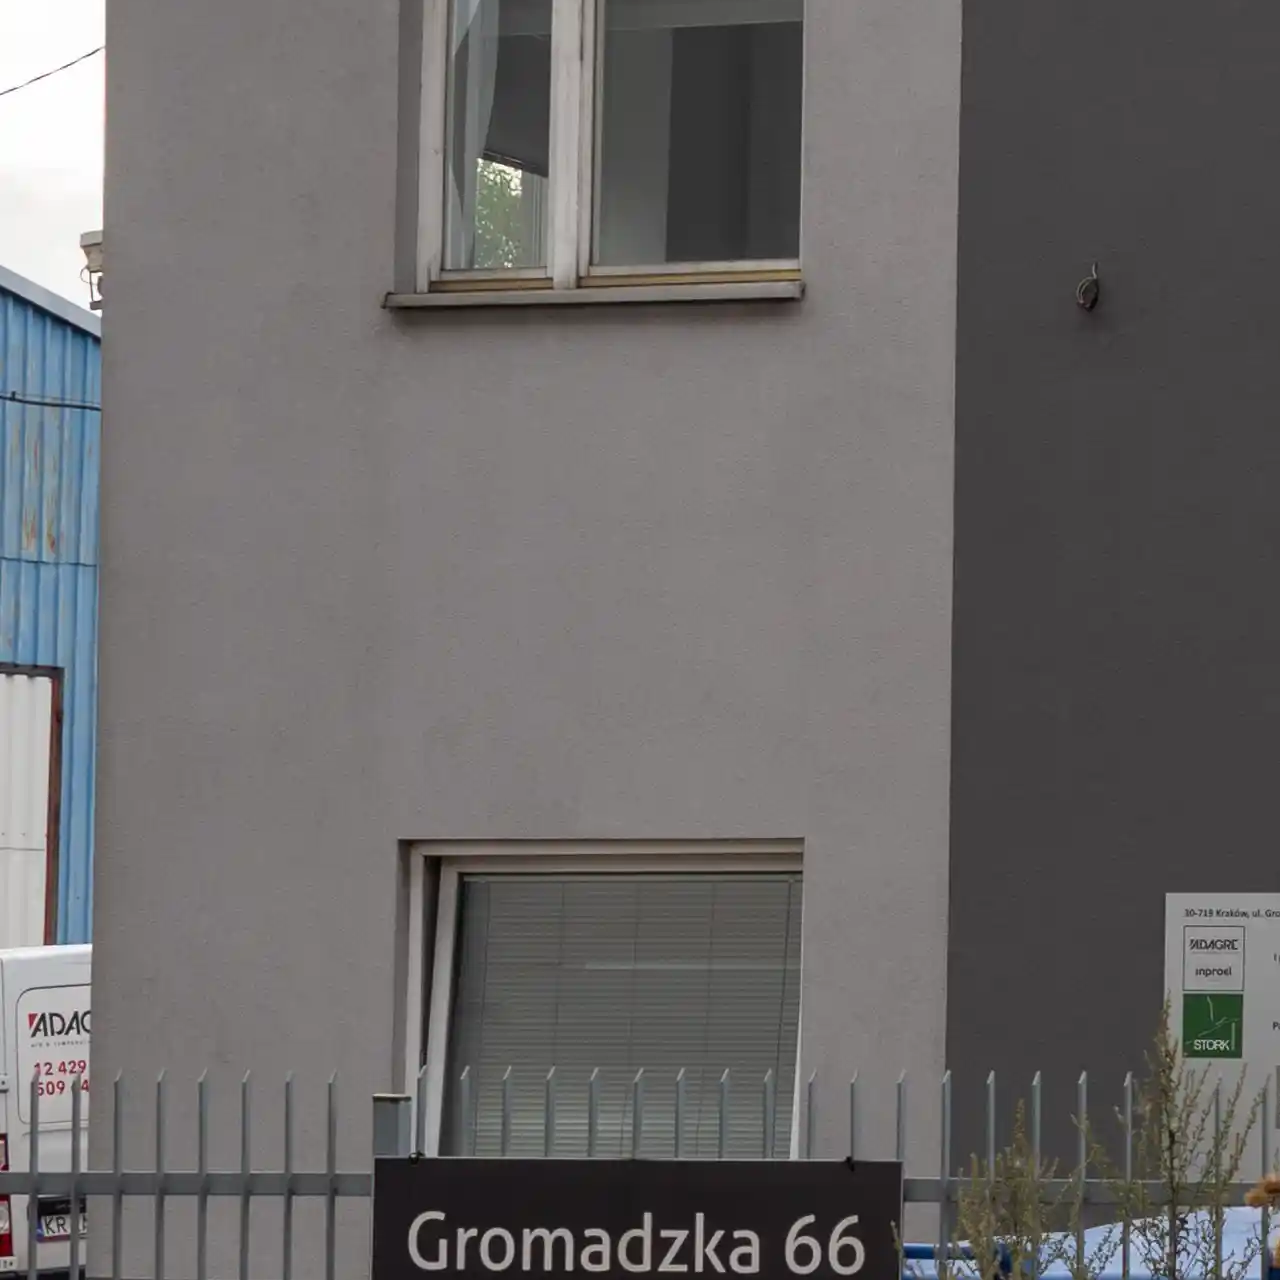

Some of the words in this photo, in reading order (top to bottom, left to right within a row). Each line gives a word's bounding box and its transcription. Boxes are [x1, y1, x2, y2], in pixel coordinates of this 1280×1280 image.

[1184, 908, 1214, 918] 30-719
[1189, 939, 1239, 950] ADAGRE
[1193, 1039, 1230, 1051] STORK
[58, 1060, 87, 1075] 429
[408, 1210, 760, 1274] Gromadzka
[784, 1214, 866, 1276] 66
